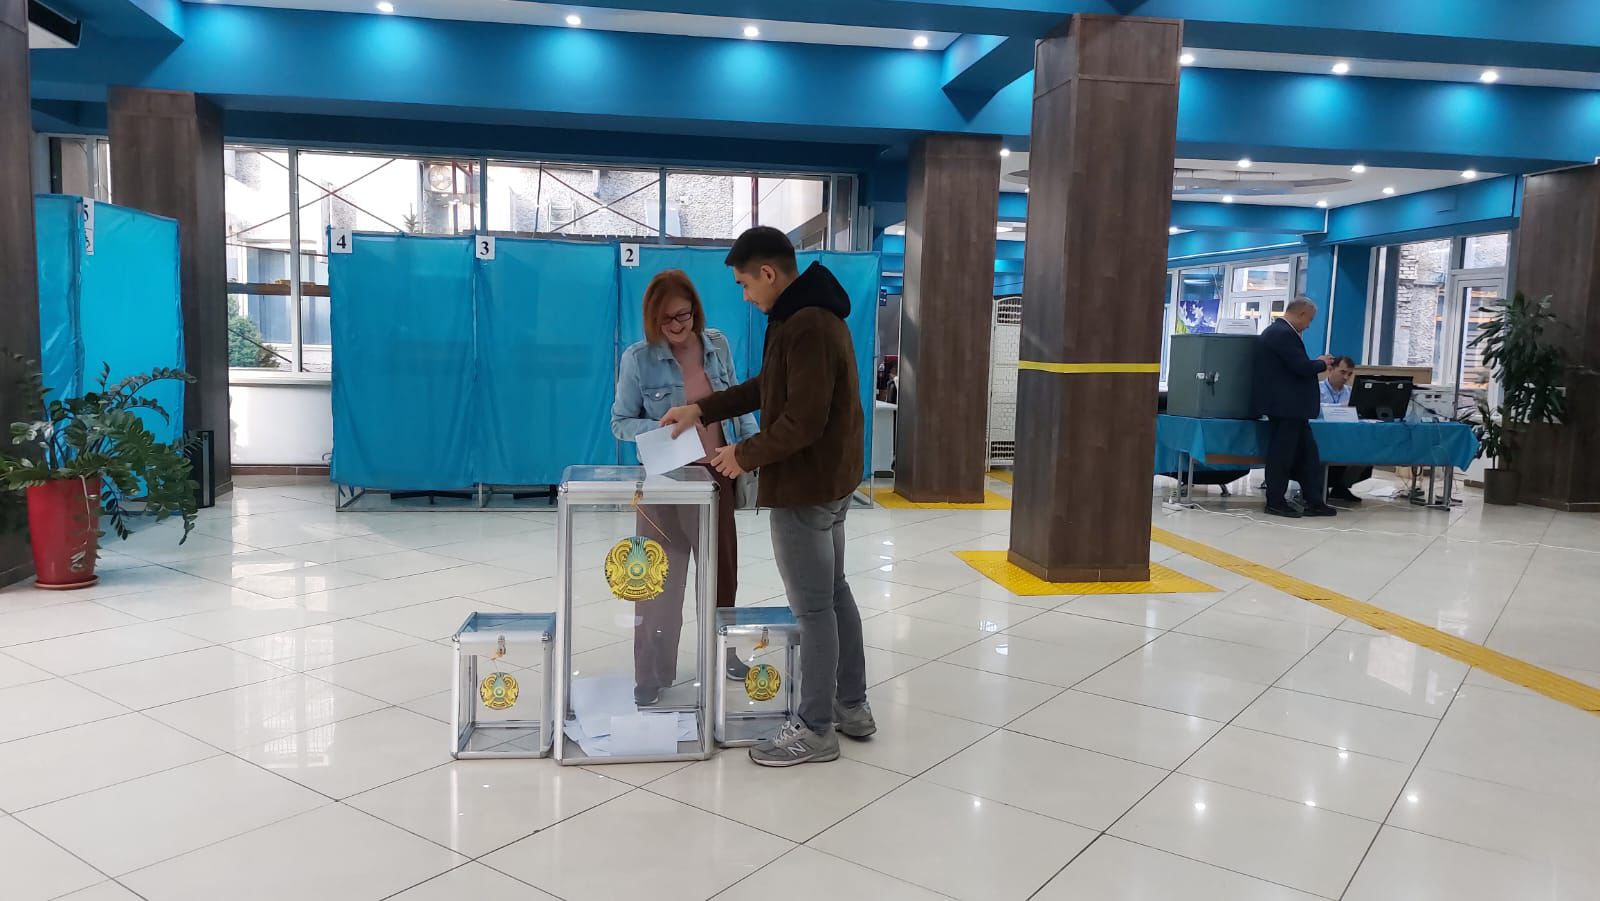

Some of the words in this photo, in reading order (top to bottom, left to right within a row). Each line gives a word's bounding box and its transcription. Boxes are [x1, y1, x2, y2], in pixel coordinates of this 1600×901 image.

[336, 234, 347, 249] 4
[479, 240, 490, 256] 3
[625, 248, 635, 263] 2
[787, 742, 806, 757] N
